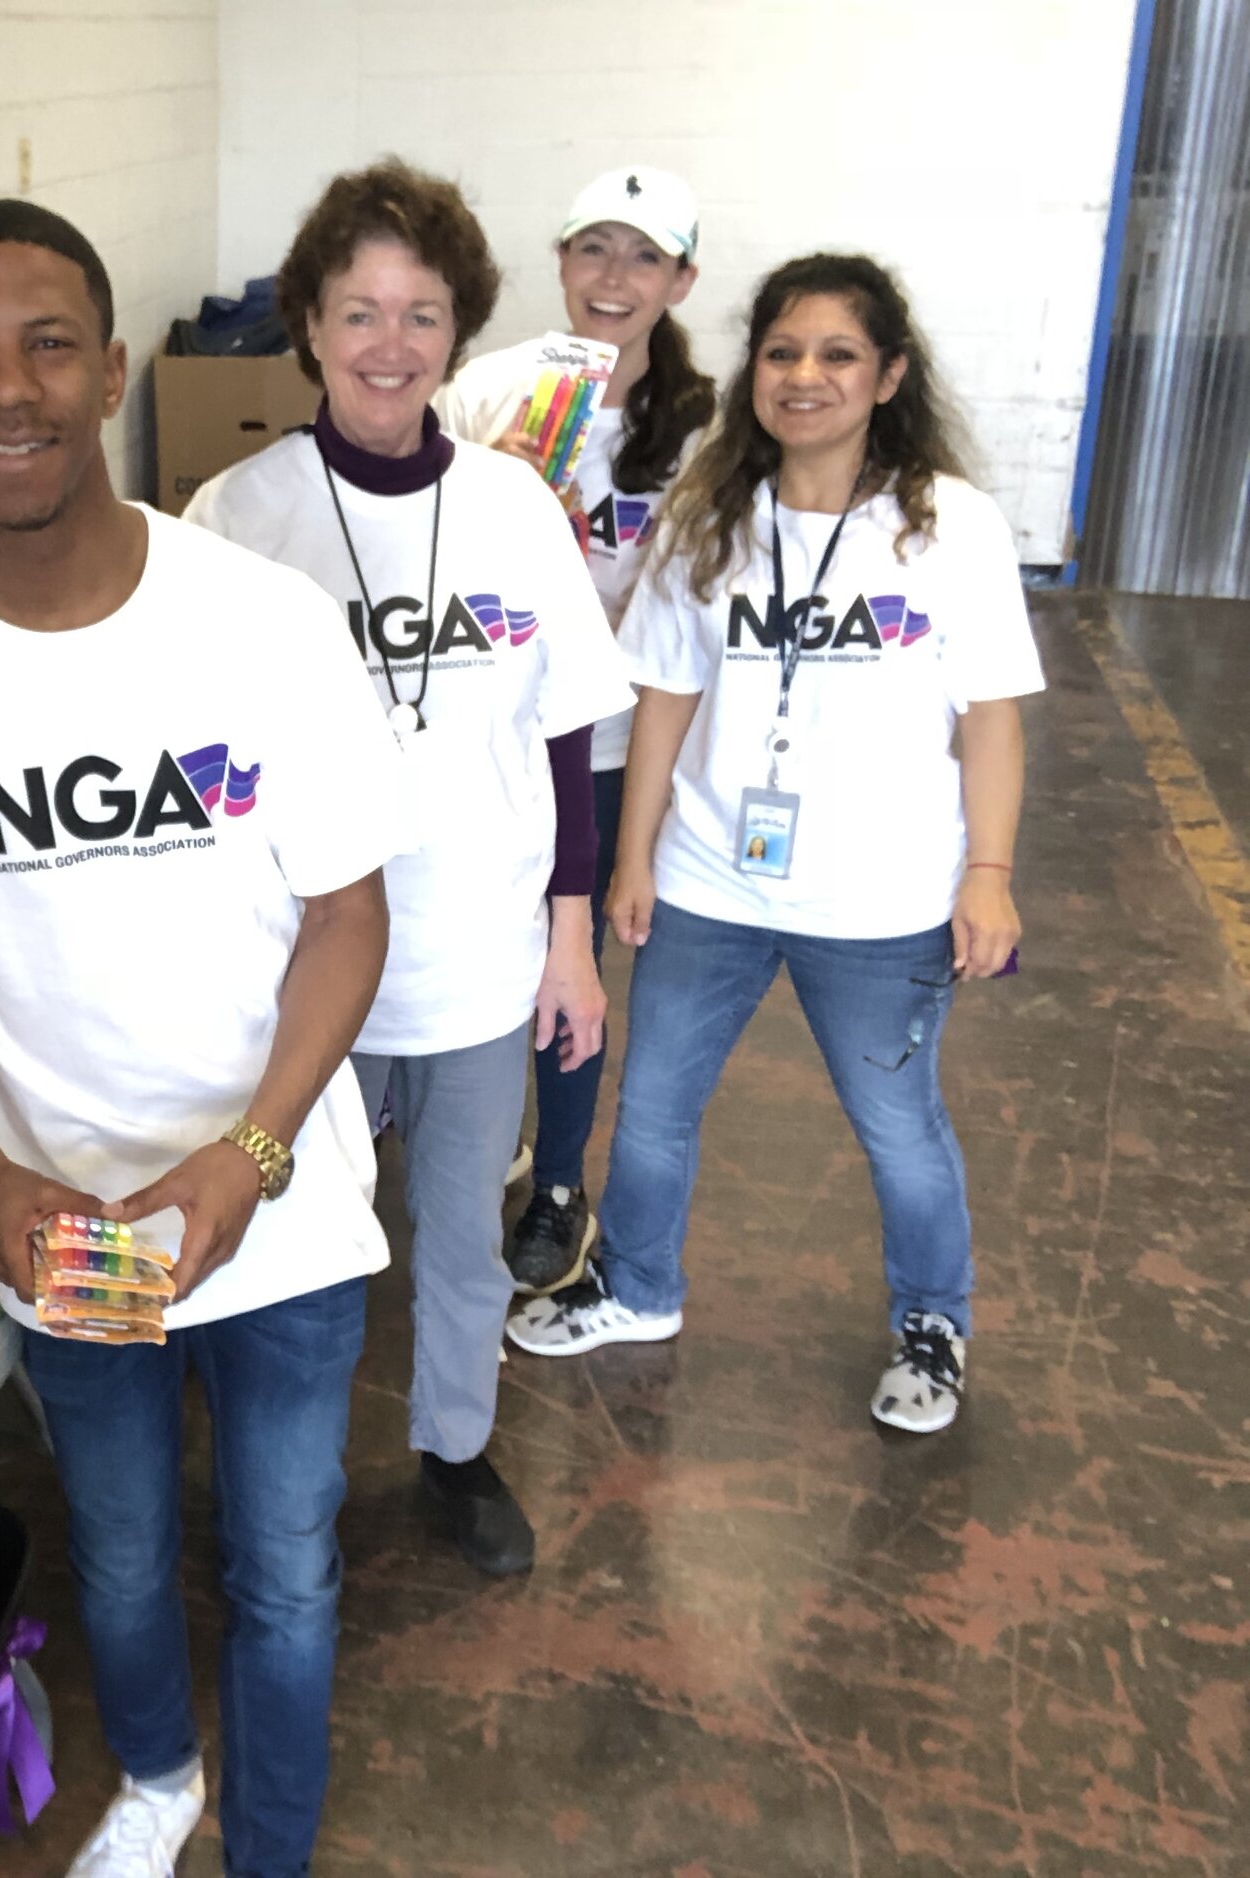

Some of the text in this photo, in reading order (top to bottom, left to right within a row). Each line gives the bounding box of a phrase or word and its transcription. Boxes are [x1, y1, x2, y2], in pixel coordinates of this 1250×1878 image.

[727, 593, 882, 650] NGA
[55, 845, 130, 868] GOVERNORS
[133, 836, 216, 857] ASSOCIATION
